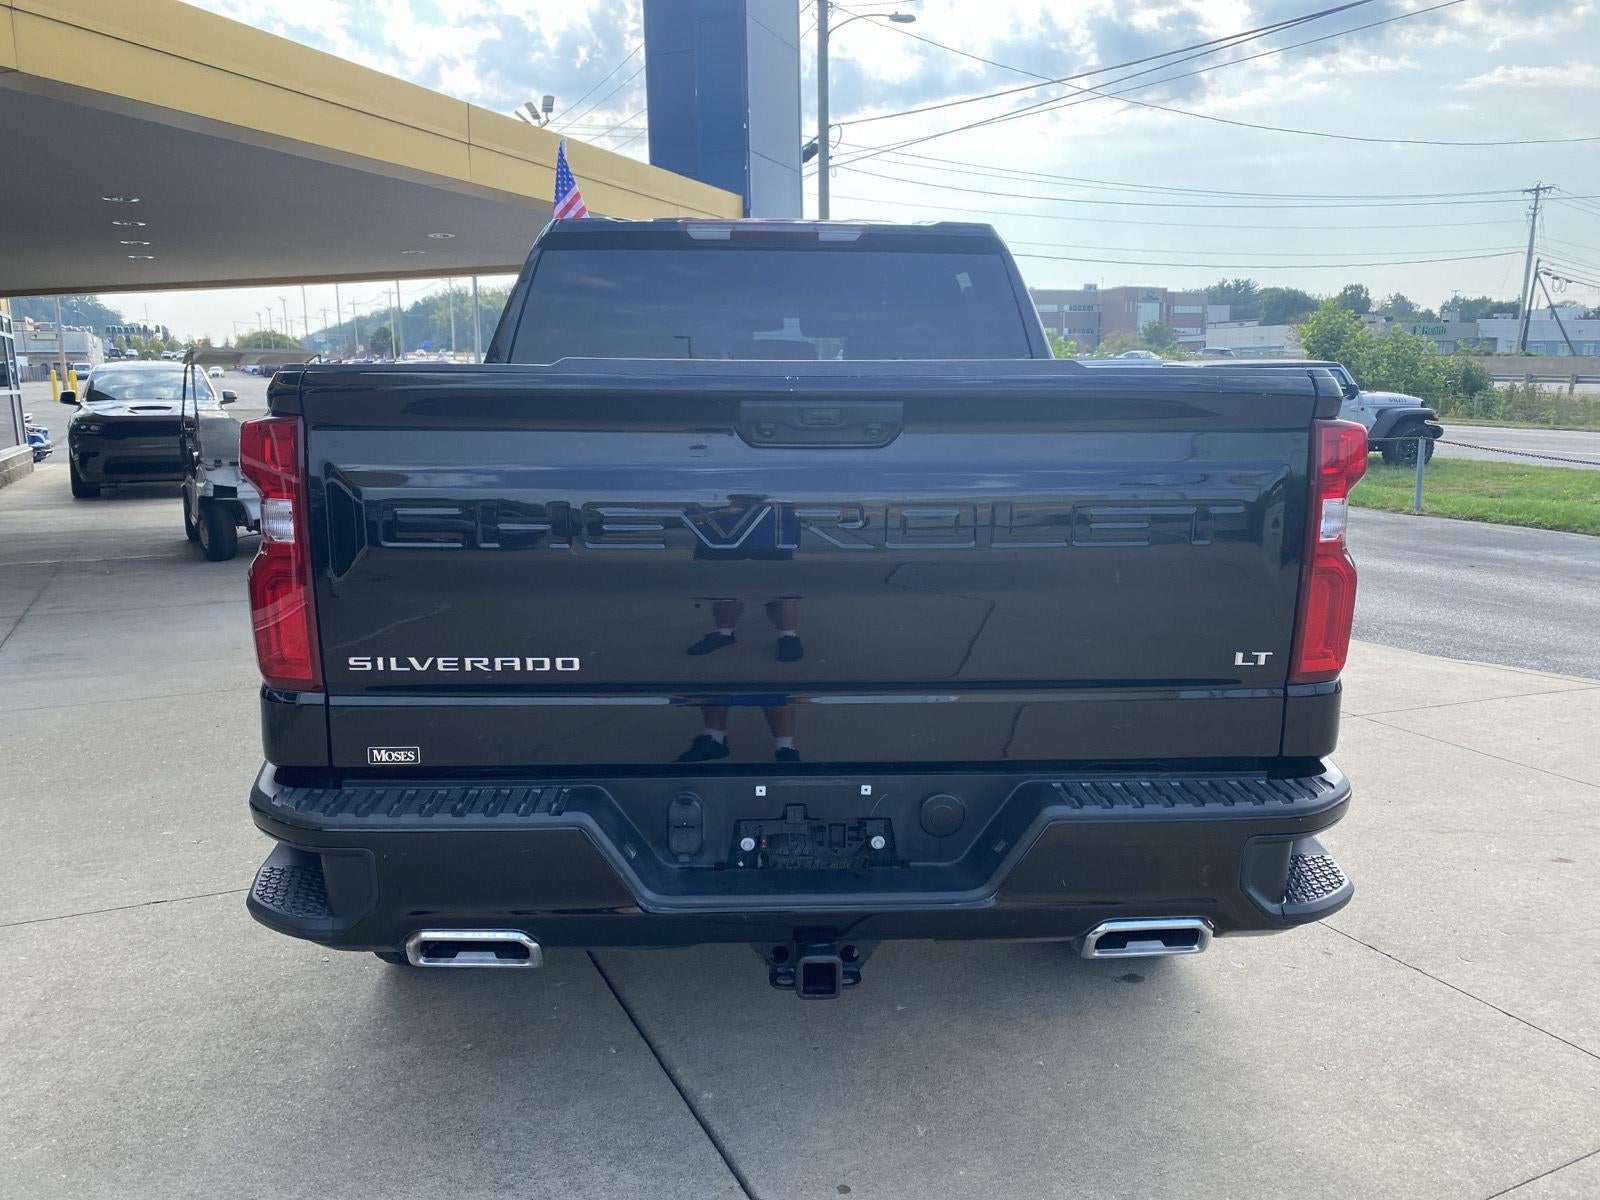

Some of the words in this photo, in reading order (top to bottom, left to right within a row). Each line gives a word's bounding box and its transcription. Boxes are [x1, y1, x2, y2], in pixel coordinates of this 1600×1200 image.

[379, 501, 1246, 549] CHEVROLET
[348, 656, 581, 672] SILVERADO
[1234, 651, 1274, 666] LT
